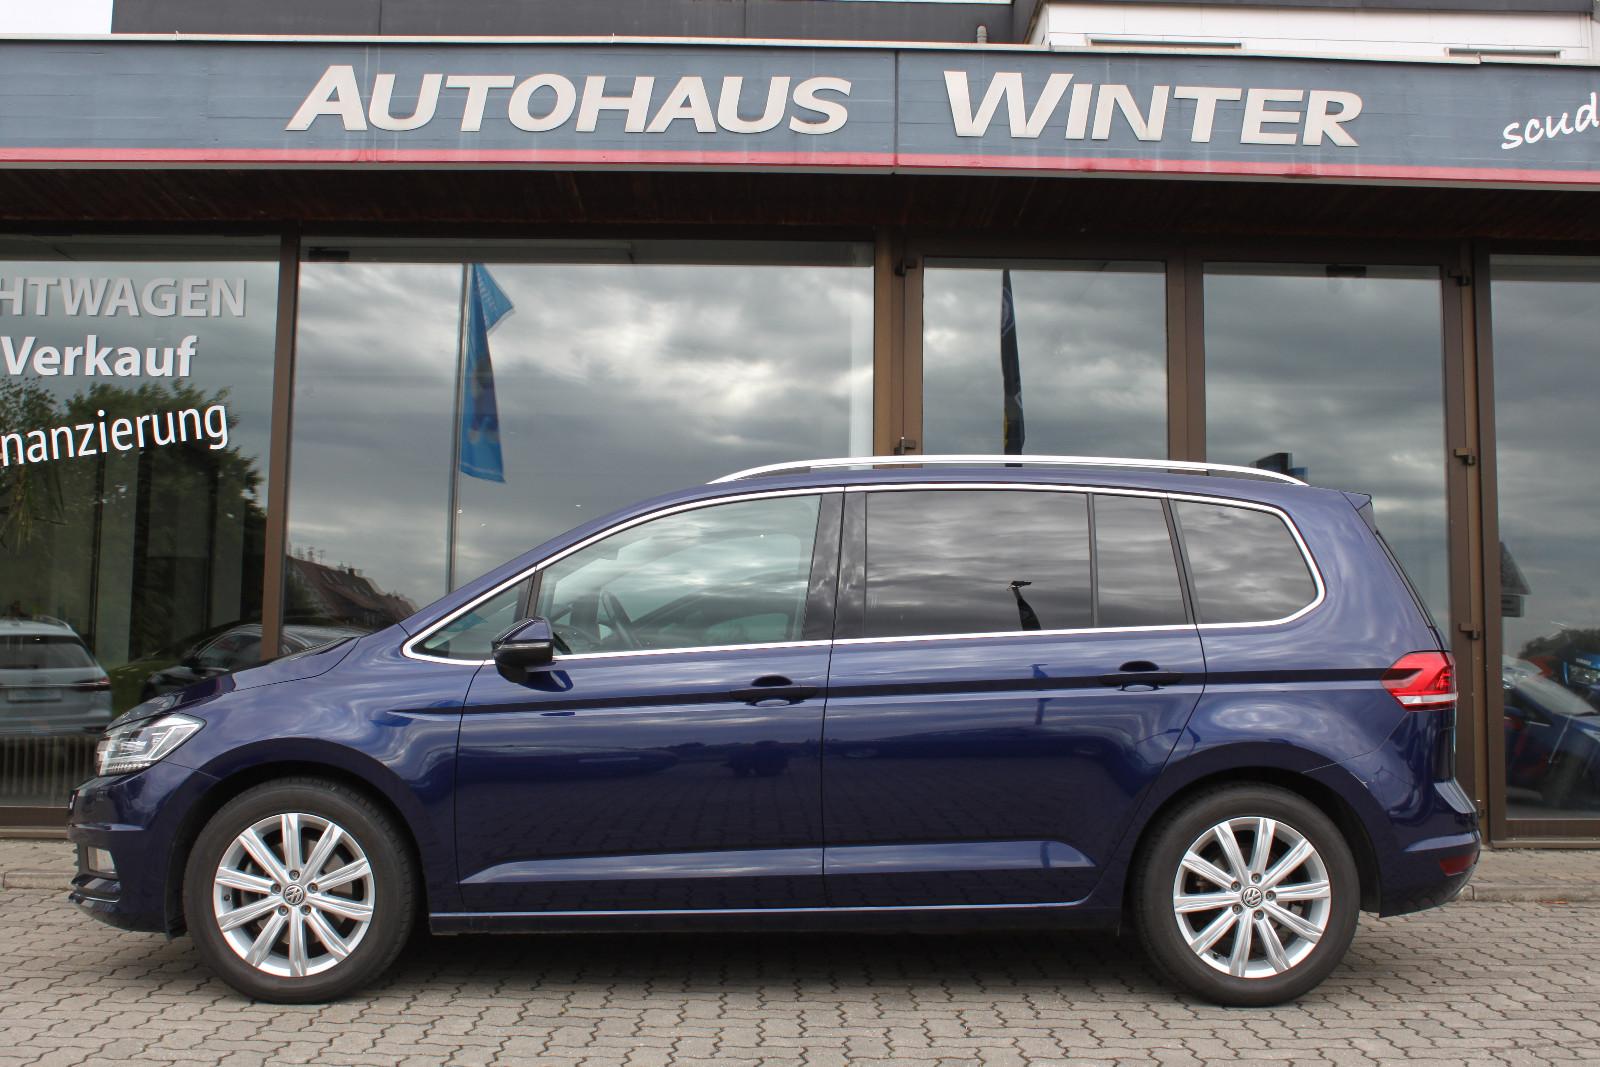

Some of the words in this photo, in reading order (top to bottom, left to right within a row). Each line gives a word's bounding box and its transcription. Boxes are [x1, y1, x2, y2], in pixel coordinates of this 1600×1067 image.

[285, 65, 852, 135] AUTOHAUS
[943, 71, 1364, 147] WINTER
[0, 334, 198, 377] Verkauf
[0, 404, 229, 467] nanzierung
